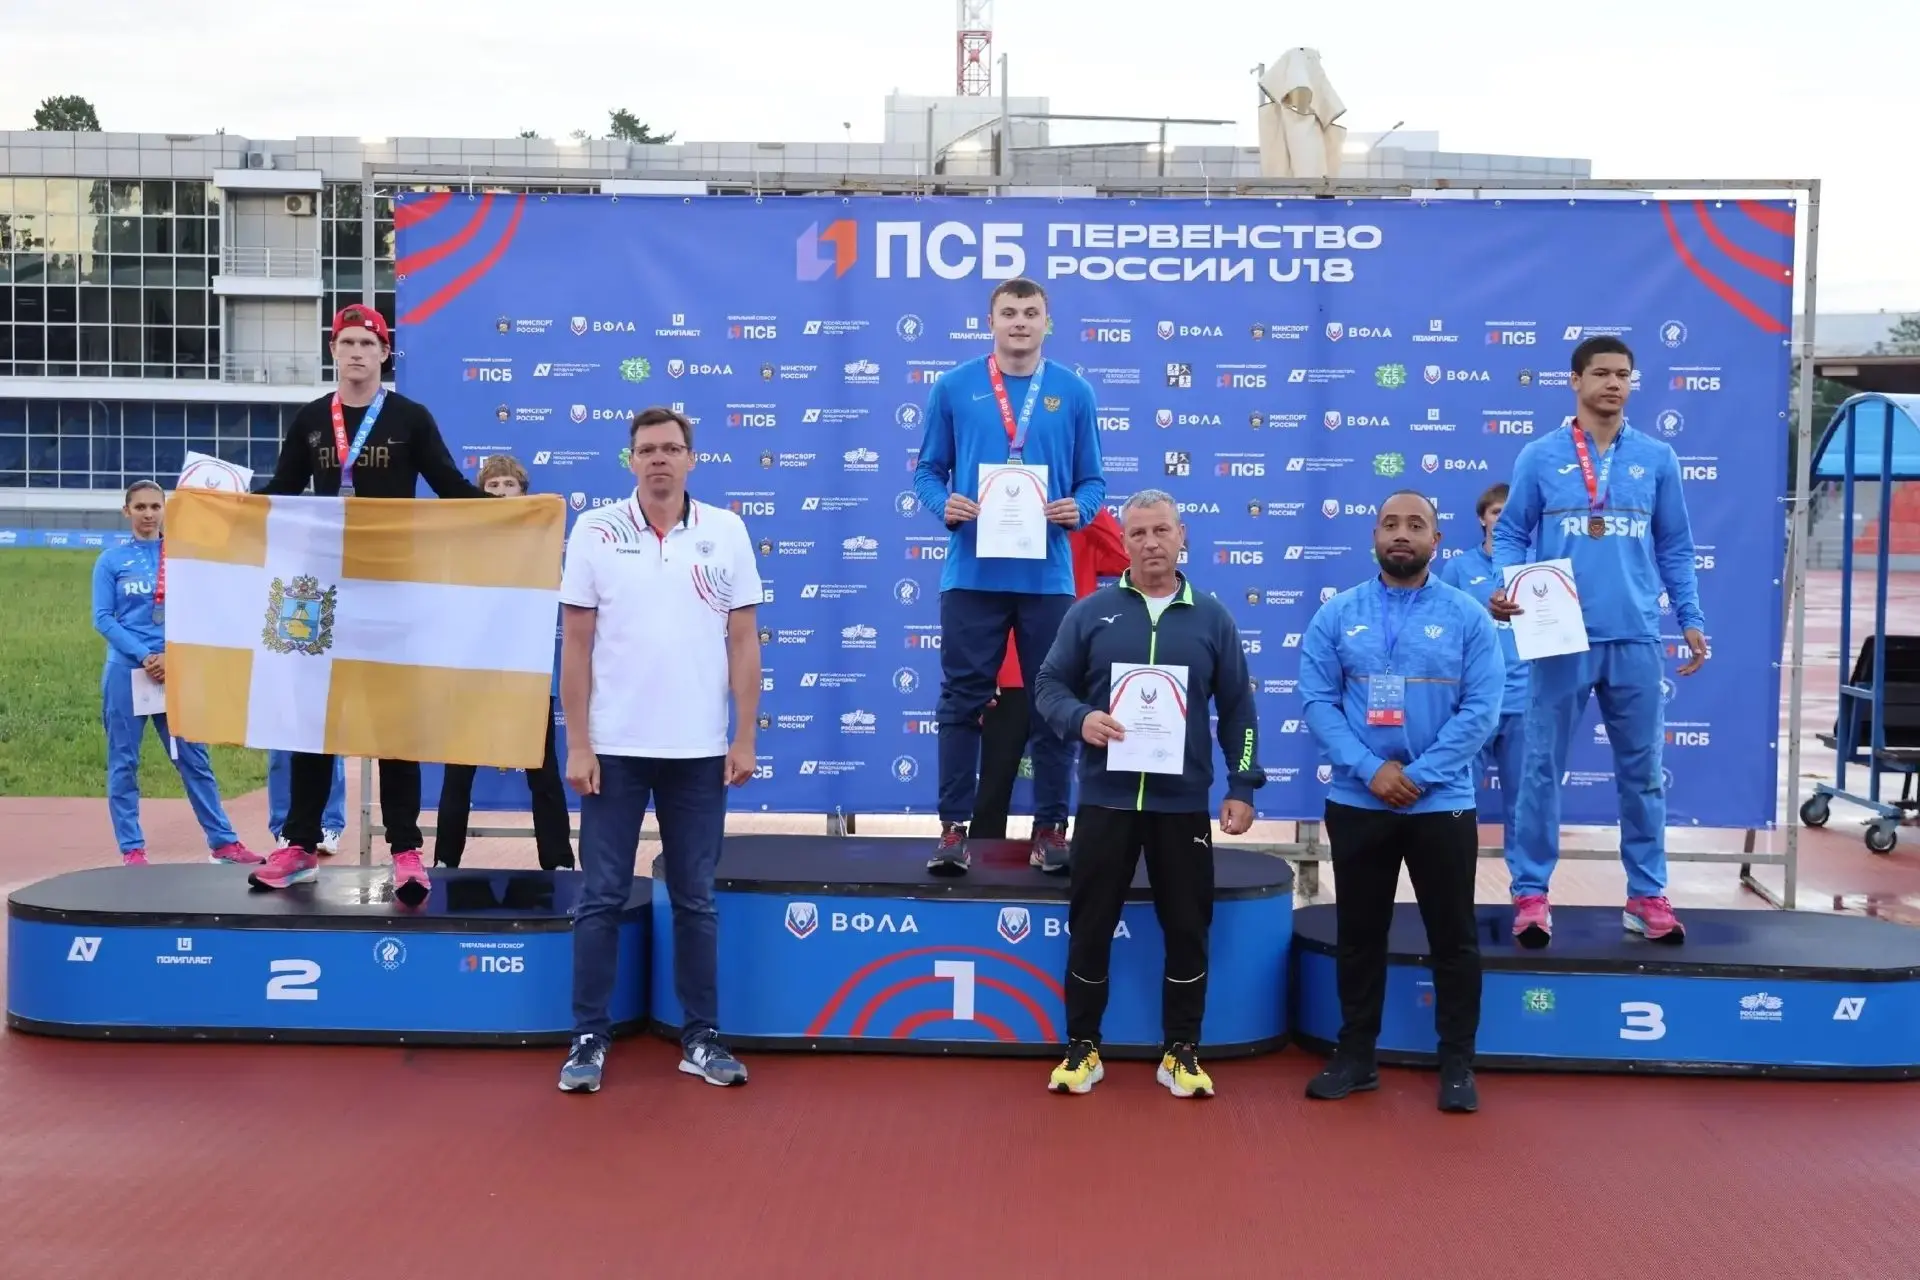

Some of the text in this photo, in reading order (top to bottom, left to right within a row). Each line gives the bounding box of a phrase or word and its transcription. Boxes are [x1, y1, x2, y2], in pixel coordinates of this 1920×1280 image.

[1048, 224, 1382, 248] ПЕРВЕНСТВО
[876, 222, 1027, 280] ПСБ
[1048, 256, 1354, 282] РОССИИ U18
[594, 322, 635, 331] ВФЛА
[744, 326, 776, 339] ПСБ
[1180, 326, 1223, 336] ВФЛА
[1349, 328, 1392, 337] ВФЛА
[1098, 329, 1131, 342] ПСБ
[1502, 332, 1536, 344] ПСБ
[480, 368, 512, 381] ПСБ
[690, 365, 732, 374] ВФЛА
[1447, 371, 1490, 381] ВФЛА
[1233, 375, 1266, 387] ПСБ
[1686, 377, 1720, 390] ПСБ
[593, 410, 635, 420] ВФЛА
[743, 415, 776, 426] ПСБ
[1179, 415, 1221, 425] ВФЛА
[1348, 416, 1390, 426] ВФЛА
[1098, 417, 1129, 430] ПСБ
[1499, 421, 1533, 434] ПСБ
[320, 447, 390, 468] RUSIA
[1231, 464, 1265, 476] ПСБ
[1444, 460, 1488, 470] ВФЛА
[1683, 467, 1717, 480] ПСБ
[742, 502, 775, 515] ПСБ
[1178, 503, 1220, 513] ВФЛА
[1345, 505, 1377, 515] ВФЛ
[1230, 551, 1263, 564] ПСБ
[1694, 556, 1714, 569] СБ
[920, 635, 941, 649] ПС
[1241, 640, 1261, 653] СБ
[1678, 645, 1711, 659] ПБ
[920, 721, 939, 734] ПС
[1676, 732, 1709, 745] ПСБ
[752, 766, 773, 779] СБ
[832, 913, 918, 932] ВФЛА
[1045, 917, 1131, 939] ВА
[157, 956, 212, 964] ПОЛИПЛАСТ
[482, 956, 524, 972] ПСБ
[266, 959, 322, 999] 2
[934, 960, 975, 1020] 1
[1619, 1002, 1666, 1040] 3
